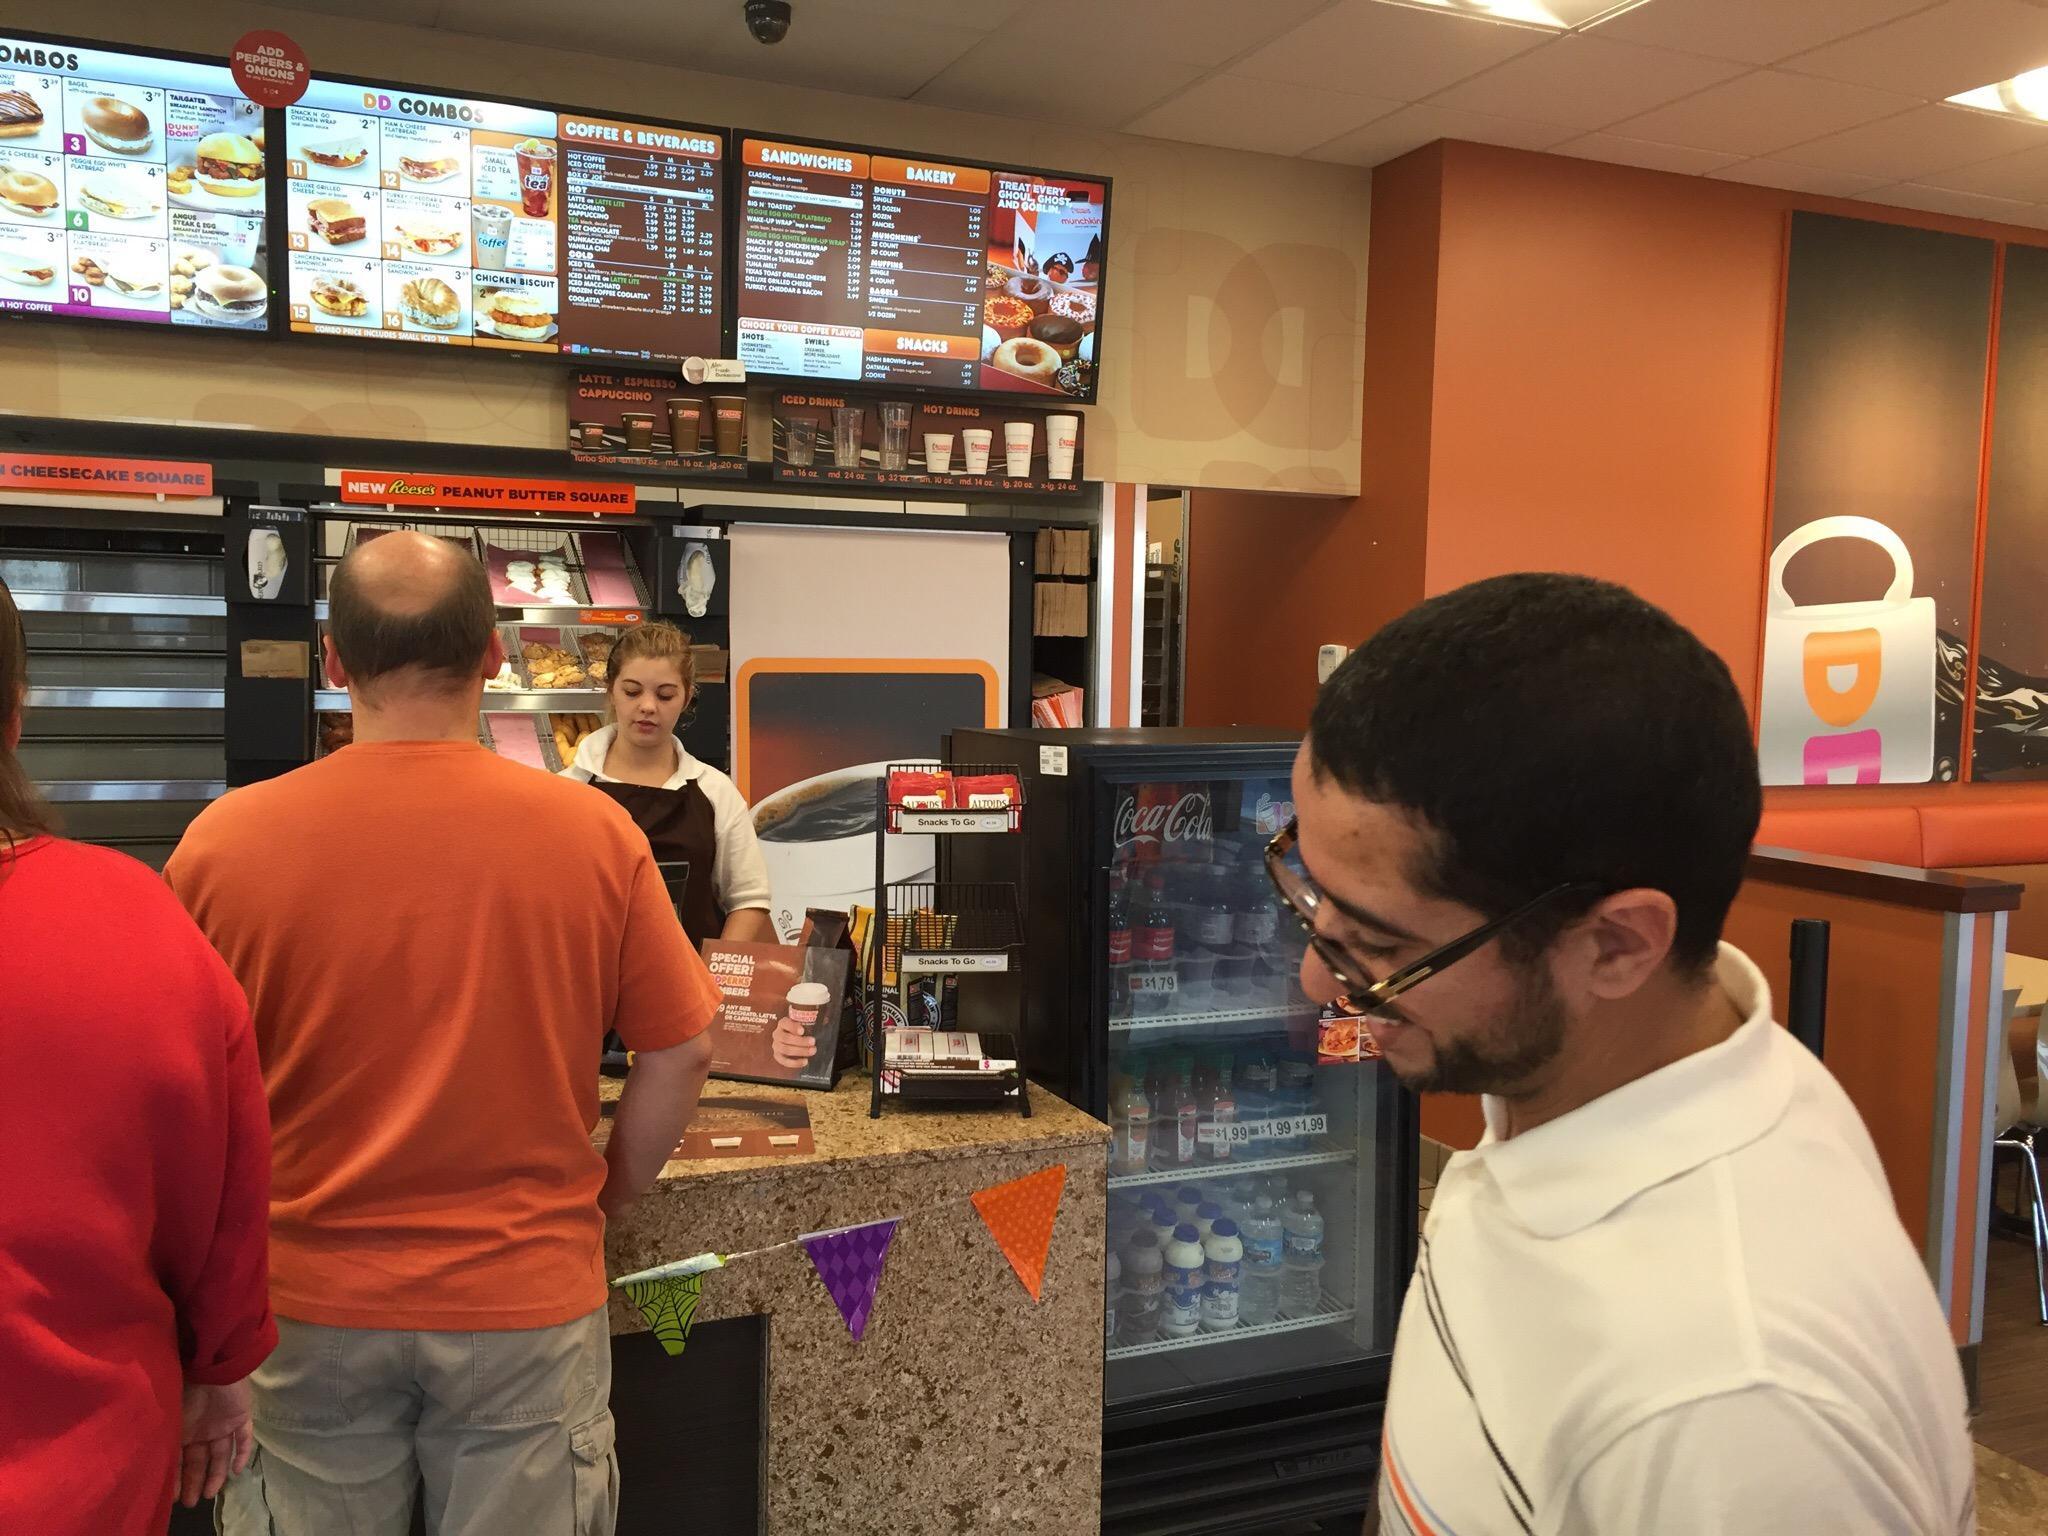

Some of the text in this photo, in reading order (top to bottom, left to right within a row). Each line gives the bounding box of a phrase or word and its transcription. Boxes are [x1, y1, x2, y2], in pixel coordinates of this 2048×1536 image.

[257, 45, 284, 58] ADD
[236, 52, 305, 72] PEPPERS &
[245, 64, 295, 80] ONIONS
[398, 97, 484, 123] COMBOS
[70, 137, 81, 151] 3
[565, 122, 715, 154] COFFEE & BEVERAGES
[484, 157, 507, 166] SMALL
[568, 153, 605, 163] HOT COFFEE
[761, 148, 853, 173] SANDWICHES
[291, 162, 304, 176] 11
[481, 164, 511, 174] ICED TEA
[568, 160, 606, 171] ICED COFFEE
[383, 172, 398, 187] 12
[748, 171, 771, 179] CLASSIC
[906, 166, 956, 185] BAKERY
[526, 176, 547, 190] tea
[998, 180, 1066, 197] TREAT EVERY
[568, 185, 588, 194] HOT
[873, 186, 906, 197] DONUTS
[998, 190, 1073, 209] GHOUL, GHOST,
[567, 203, 605, 213] MACCHIATO
[997, 199, 1061, 214] AND GOBLIN.
[73, 213, 83, 227] 6
[173, 213, 197, 221] ANGUS
[567, 210, 609, 220] CAPPUCCINO
[173, 220, 194, 228] STEAK
[583, 225, 620, 235] CHOCOLATE
[384, 243, 400, 258] 14
[568, 260, 595, 269] ICED TEA
[763, 261, 777, 269] MELT
[475, 273, 555, 288] CHICKEN BISCUIT
[568, 279, 621, 290] ICED MACCHIATO
[72, 288, 89, 302] 10
[568, 287, 593, 295] FROZEN
[593, 289, 616, 297] COFFEE
[7, 302, 53, 312] HOT COFFEE
[292, 305, 307, 319] 15
[386, 313, 400, 327] 16
[741, 319, 861, 338] CHOOSE YOUR COFFEE FLAVOR
[741, 332, 765, 341] SHOTS
[804, 338, 830, 346] SWIRLS
[896, 336, 949, 353] SNACKS
[579, 374, 677, 389] LATTE ESPRESSO
[579, 388, 652, 401] CAPPUCCINO
[782, 395, 846, 408] ICED DRINKS
[923, 405, 980, 417] HOT DRINKS
[573, 454, 617, 463] Turbo Shot
[665, 459, 681, 467] md.
[683, 459, 691, 467] 16
[721, 461, 732, 469] 20
[11, 464, 206, 485] CHEESECAKE SQUARE
[798, 469, 806, 477] 16
[844, 471, 854, 480] 24
[888, 474, 898, 482] 32
[934, 476, 942, 484] 10
[959, 477, 972, 485] md.
[975, 478, 983, 486] 14
[1013, 480, 1023, 488] 20
[1057, 482, 1067, 490] 24
[348, 479, 629, 504] NEW Reese's PEANUT BUTTER SQUARE
[972, 799, 1007, 809] ALTOIDS
[918, 818, 949, 826] Snacks
[710, 952, 756, 965] SPECIAL
[918, 957, 949, 965] Snacks
[709, 962, 754, 976] OFFER!
[1145, 976, 1175, 991] $1.79
[1259, 1120, 1292, 1138] $1.99
[1295, 1116, 1325, 1132] $1.99
[1215, 1125, 1248, 1141] $1.99
